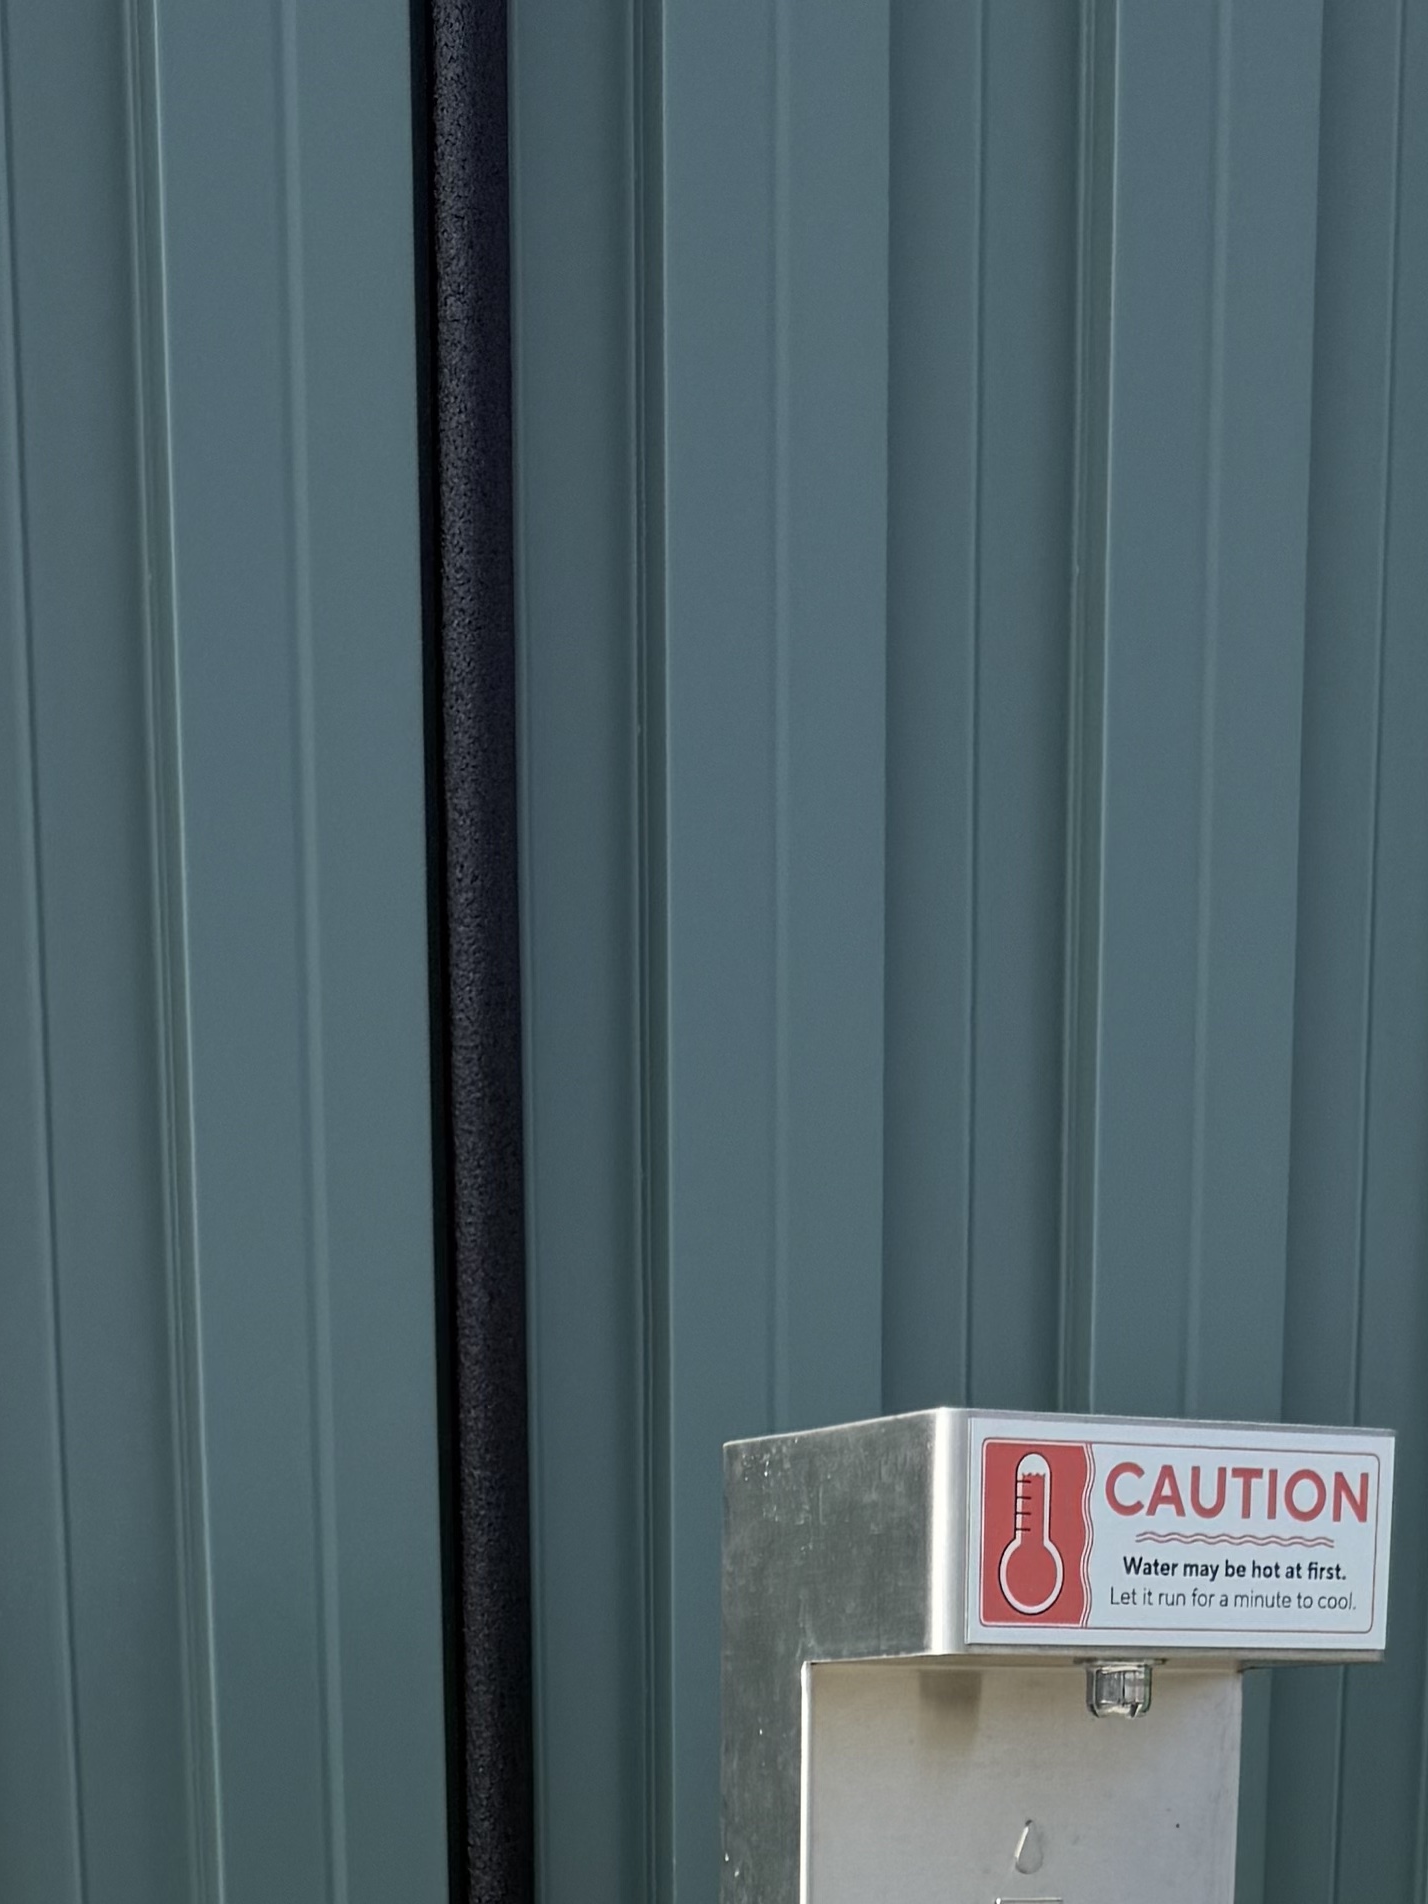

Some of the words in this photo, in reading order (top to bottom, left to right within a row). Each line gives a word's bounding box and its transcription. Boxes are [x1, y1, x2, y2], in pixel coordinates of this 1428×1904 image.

[1104, 1461, 1370, 1523] CAUTION
[1123, 1556, 1178, 1577] Water
[1183, 1563, 1219, 1582] may
[1225, 1559, 1246, 1578] be
[1252, 1559, 1280, 1579] hot
[1285, 1562, 1302, 1579] at
[1308, 1561, 1346, 1580] first.
[1110, 1586, 1137, 1605] Let
[1143, 1587, 1153, 1606] it
[1159, 1593, 1186, 1606] run
[1192, 1587, 1215, 1608] for
[1219, 1594, 1229, 1607] a
[1234, 1589, 1292, 1608] minute
[1297, 1592, 1313, 1609] to
[1317, 1591, 1356, 1610] cool.
